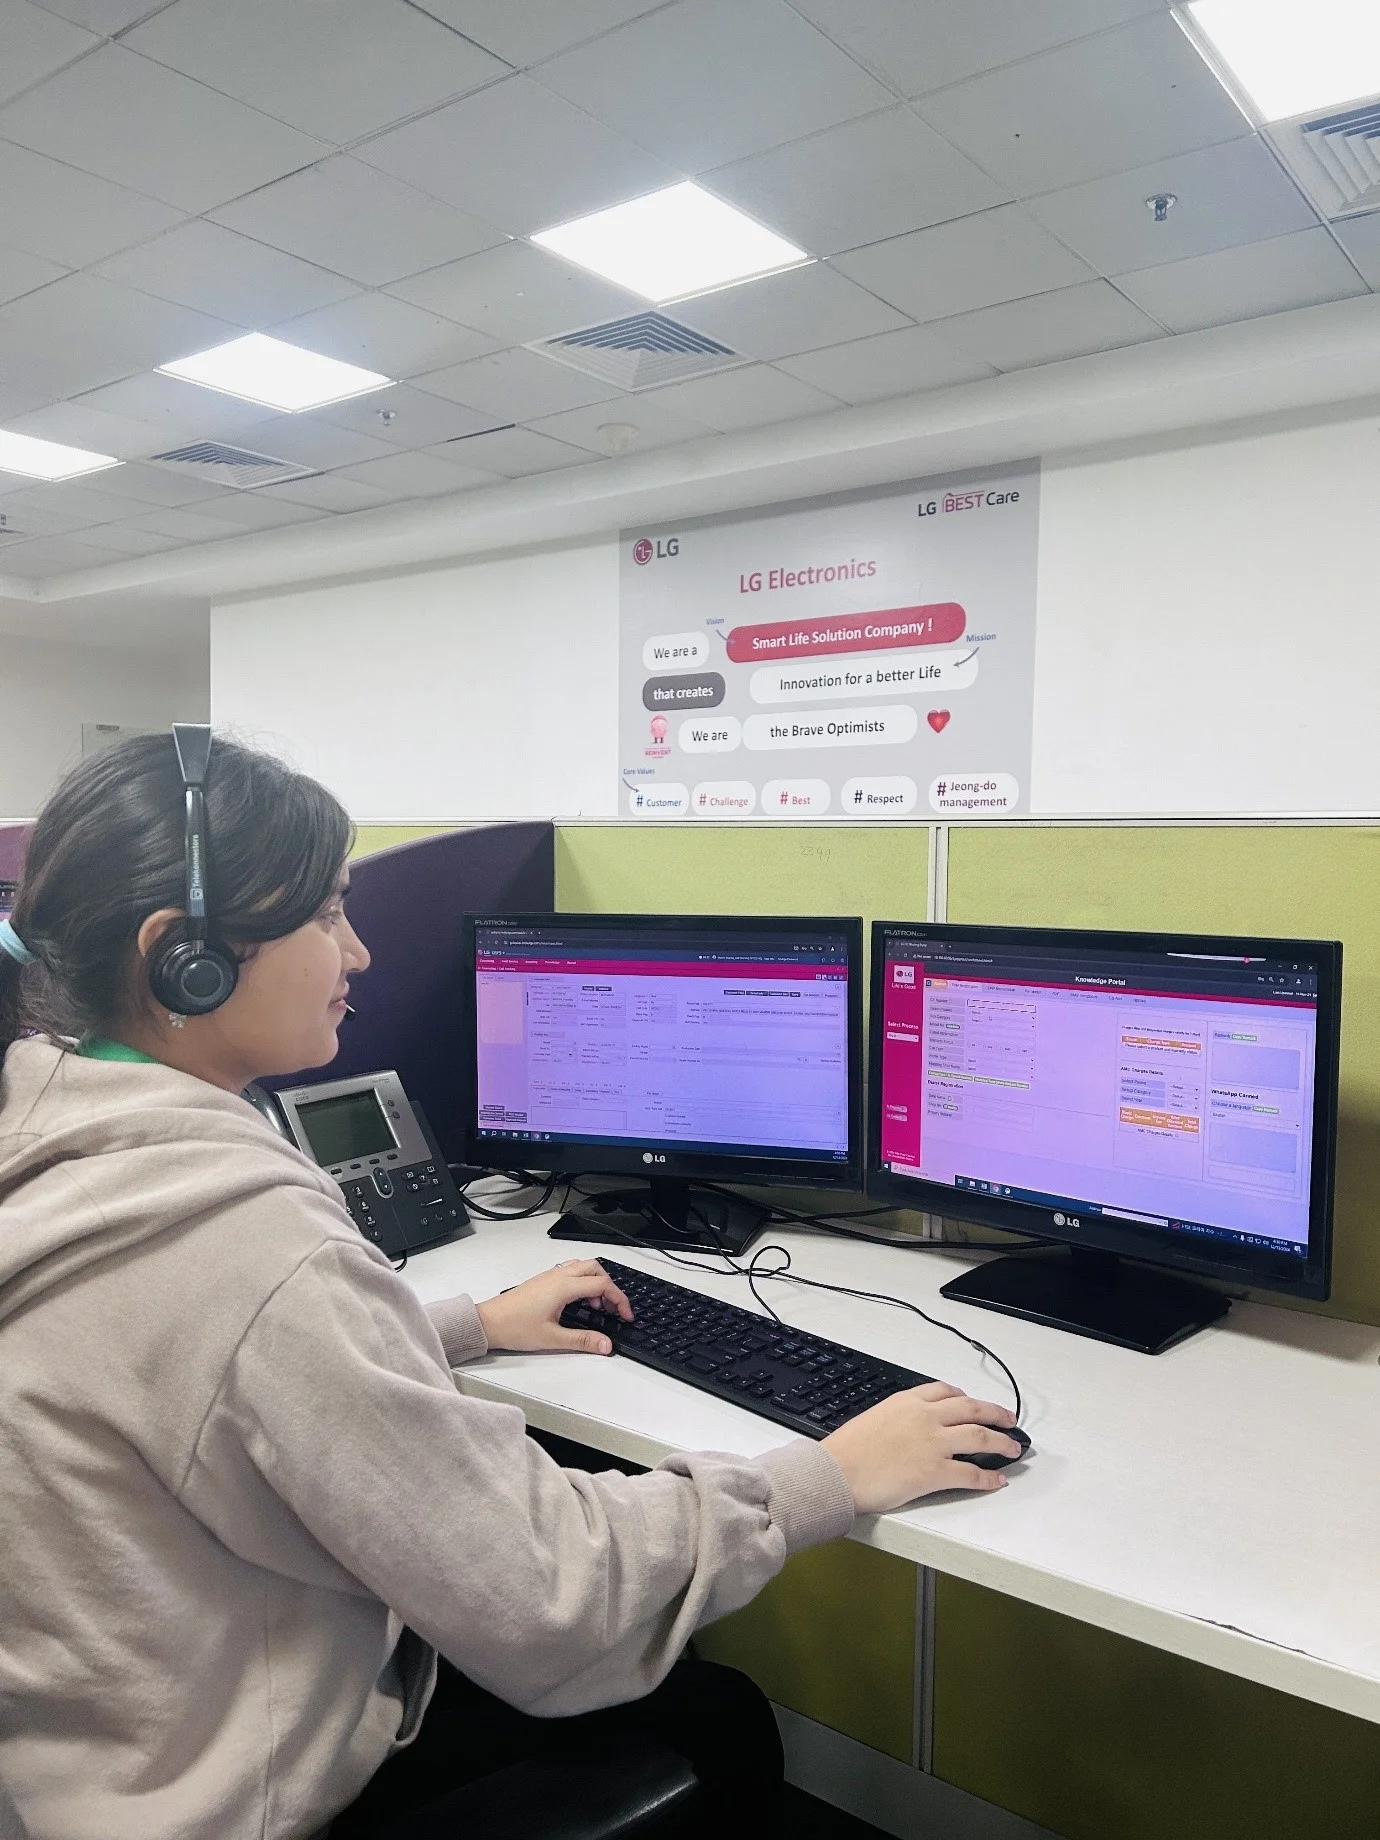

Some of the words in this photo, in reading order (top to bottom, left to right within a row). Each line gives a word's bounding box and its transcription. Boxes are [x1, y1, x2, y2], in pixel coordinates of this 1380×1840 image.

[918, 502, 936, 516] LG
[943, 491, 984, 513] BEST
[986, 491, 1020, 506] Care
[656, 538, 680, 558] LG
[740, 572, 762, 593] LG
[768, 558, 877, 590] Electronics
[752, 635, 786, 650] Smart
[789, 632, 810, 646] Life
[812, 628, 862, 645] Solution
[864, 621, 925, 641] Company
[927, 618, 932, 632] !
[966, 632, 997, 643] Mission
[654, 648, 670, 659] We
[672, 647, 689, 657] are
[691, 647, 698, 656] a
[780, 675, 842, 691] Innovation
[845, 672, 862, 686] for
[866, 674, 873, 684] a
[876, 667, 915, 683] better
[919, 666, 942, 679] Life
[653, 688, 675, 700] that
[676, 687, 714, 699] creates
[770, 725, 789, 737] the
[792, 725, 824, 737] Brave
[827, 720, 885, 737] Optimists
[692, 731, 709, 742] We
[711, 731, 728, 741] are
[937, 782, 947, 796] #
[950, 781, 997, 793] Jeong-do
[636, 794, 643, 807] #
[646, 798, 682, 807] Customer
[699, 794, 707, 806] #
[710, 797, 749, 808] Challenge
[780, 791, 788, 804] #
[792, 796, 811, 805] Best
[854, 789, 863, 803] #
[867, 794, 904, 806] Respect
[939, 797, 1007, 808] management
[1075, 976, 1107, 985] Knowledge
[1108, 978, 1126, 986] Portal
[1211, 1088, 1238, 1097] WhatsApp
[654, 1154, 666, 1163] LG
[1067, 1217, 1080, 1228] LG
